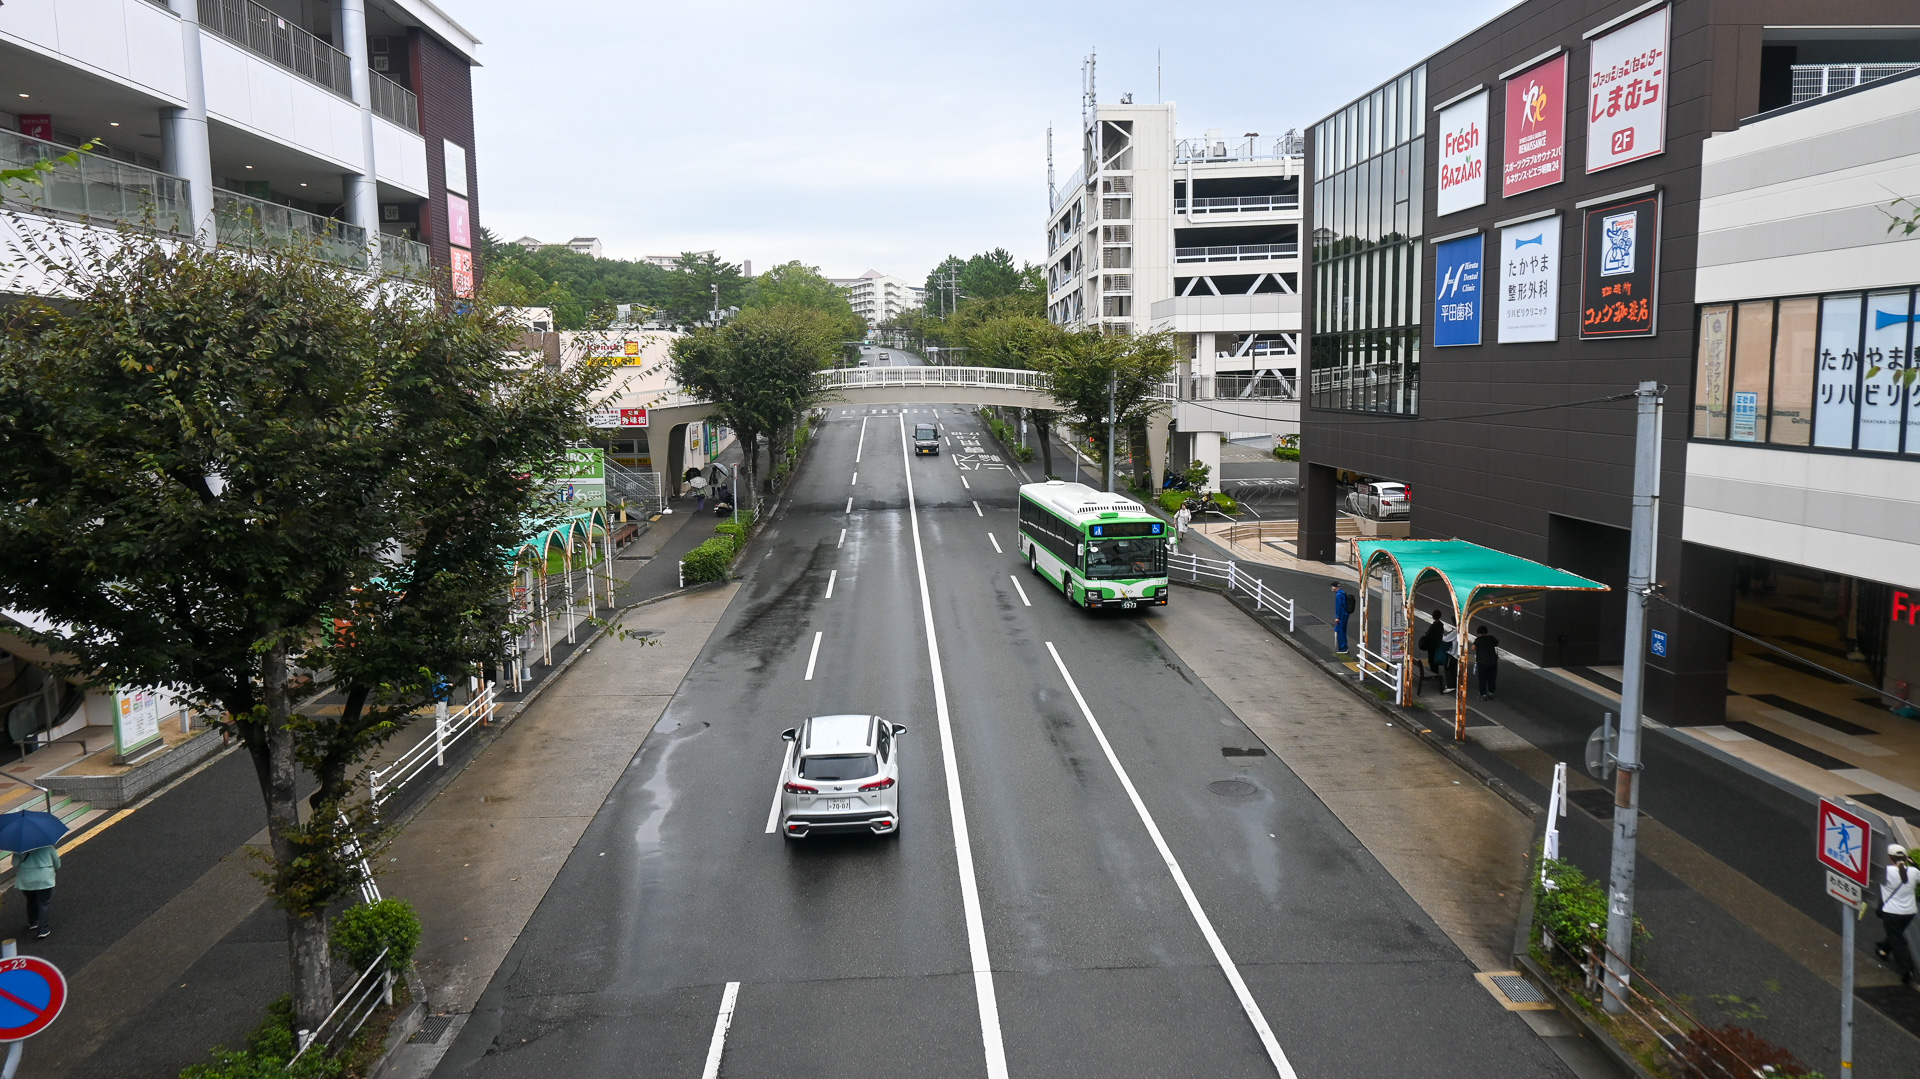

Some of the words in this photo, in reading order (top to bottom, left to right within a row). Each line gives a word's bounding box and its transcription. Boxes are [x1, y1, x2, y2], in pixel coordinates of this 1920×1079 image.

[376, 60, 388, 69] RF
[1592, 49, 1662, 88] ファッションセンター
[1591, 69, 1662, 123] しまむら
[1614, 130, 1632, 152] 2F
[1441, 158, 1482, 190] BAZAAR
[386, 208, 398, 218] 3F
[1463, 271, 1479, 282] Dental
[1508, 253, 1549, 278] たかやま
[1461, 283, 1476, 293] Clinic
[1507, 279, 1549, 302] 整形外科
[1440, 301, 1474, 322] 平田歯科
[1506, 306, 1548, 319] リハビリクリニック
[1584, 298, 1649, 326] コメダ珈琲店
[1713, 338, 1724, 405] テイクアウト
[1892, 591, 1920, 626] Fr
[1829, 876, 1858, 897] わたるな
